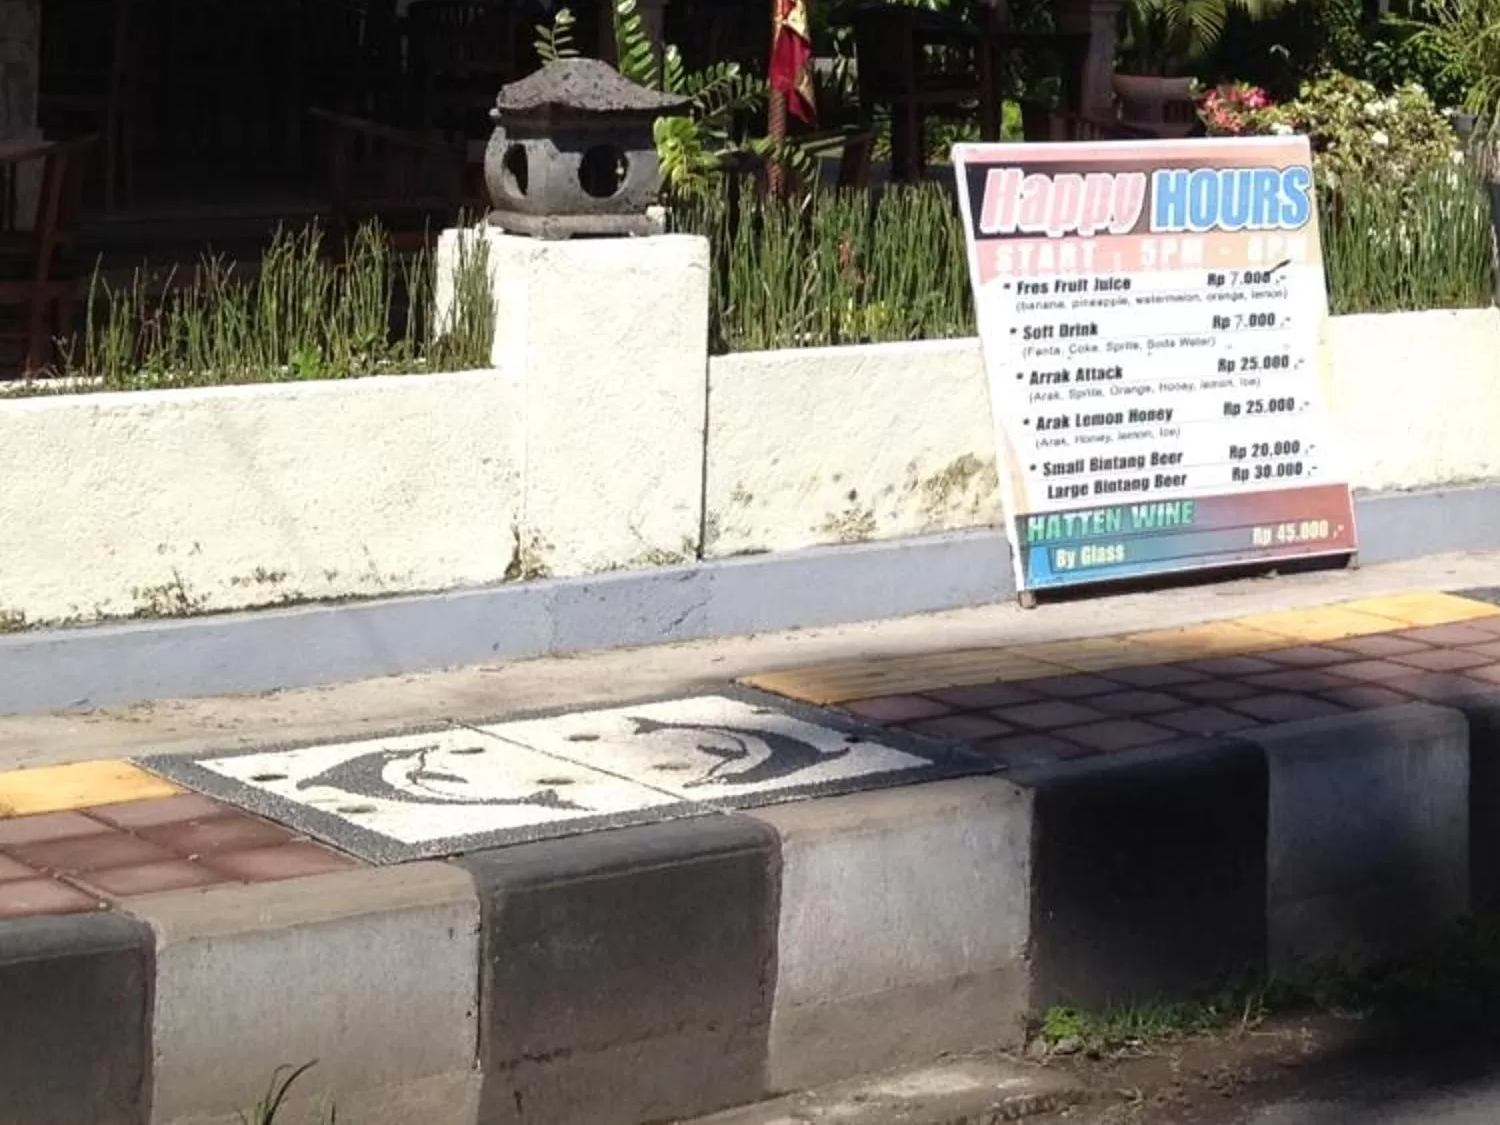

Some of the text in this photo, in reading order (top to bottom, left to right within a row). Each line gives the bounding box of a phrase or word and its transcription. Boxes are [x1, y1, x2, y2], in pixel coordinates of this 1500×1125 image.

[980, 165, 1312, 237] Happy HOURS
[1054, 278, 1089, 293] Fruit
[1094, 276, 1131, 291] Juice
[1023, 324, 1054, 340] Soft
[1059, 322, 1098, 338] Drink
[1075, 365, 1123, 383] Attack
[1036, 414, 1070, 432] Arak
[1075, 412, 1124, 428] Lemon
[1128, 408, 1173, 423] Honey
[1043, 458, 1085, 477] Small
[1089, 454, 1146, 473] Bintang
[1150, 450, 1184, 467] Beer
[1047, 482, 1089, 500] Large
[1093, 477, 1150, 495] Bintang
[1154, 472, 1188, 489] Beer
[1027, 500, 1195, 543] HATTEN WINE
[1055, 548, 1076, 570] By
[1081, 544, 1125, 567] Glass
